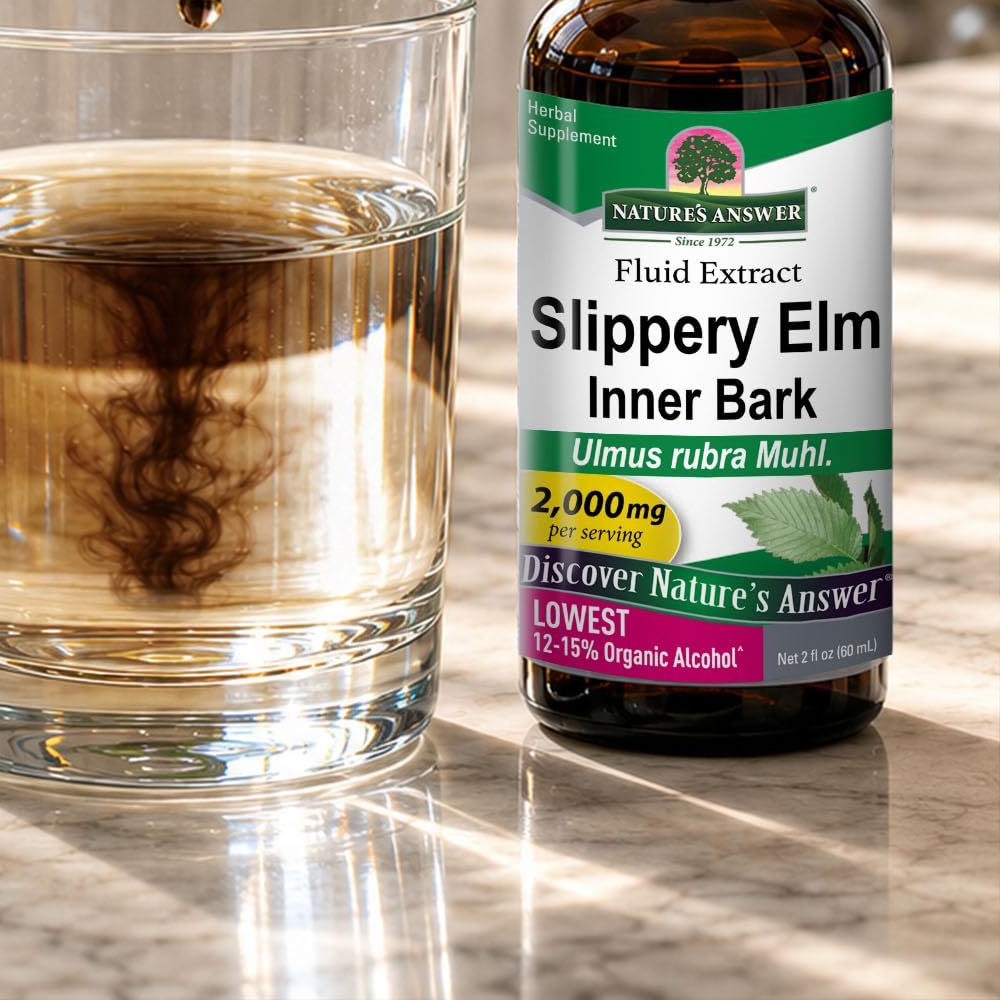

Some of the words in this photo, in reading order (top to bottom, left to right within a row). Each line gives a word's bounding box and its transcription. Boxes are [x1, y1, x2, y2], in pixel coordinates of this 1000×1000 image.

[527, 99, 577, 123] Herbal
[527, 119, 617, 148] Supplement
[711, 204, 802, 224] ANSWER
[675, 237, 704, 247] Since
[708, 237, 735, 247] 1972
[615, 258, 690, 284] Fluid
[700, 261, 802, 284] Extract
[531, 296, 759, 369] Slippery
[779, 300, 881, 353] Elm
[589, 375, 701, 421] Inner
[716, 377, 818, 421] Bark
[572, 438, 662, 469] Ulmus
[671, 442, 747, 469] rubra
[756, 439, 832, 469] Muhl.
[547, 523, 577, 542] per
[580, 527, 643, 548] serving
[520, 554, 643, 594] Discover
[651, 567, 770, 613] Nature's
[533, 599, 629, 637] LOWEST
[533, 632, 599, 661] 12-15%
[604, 643, 667, 669] Organic
[778, 651, 799, 666] Net
[801, 651, 809, 664] 2
[811, 648, 819, 662] fl
[821, 649, 834, 660] oz
[837, 644, 855, 660] (60
[857, 640, 877, 654] mL)
